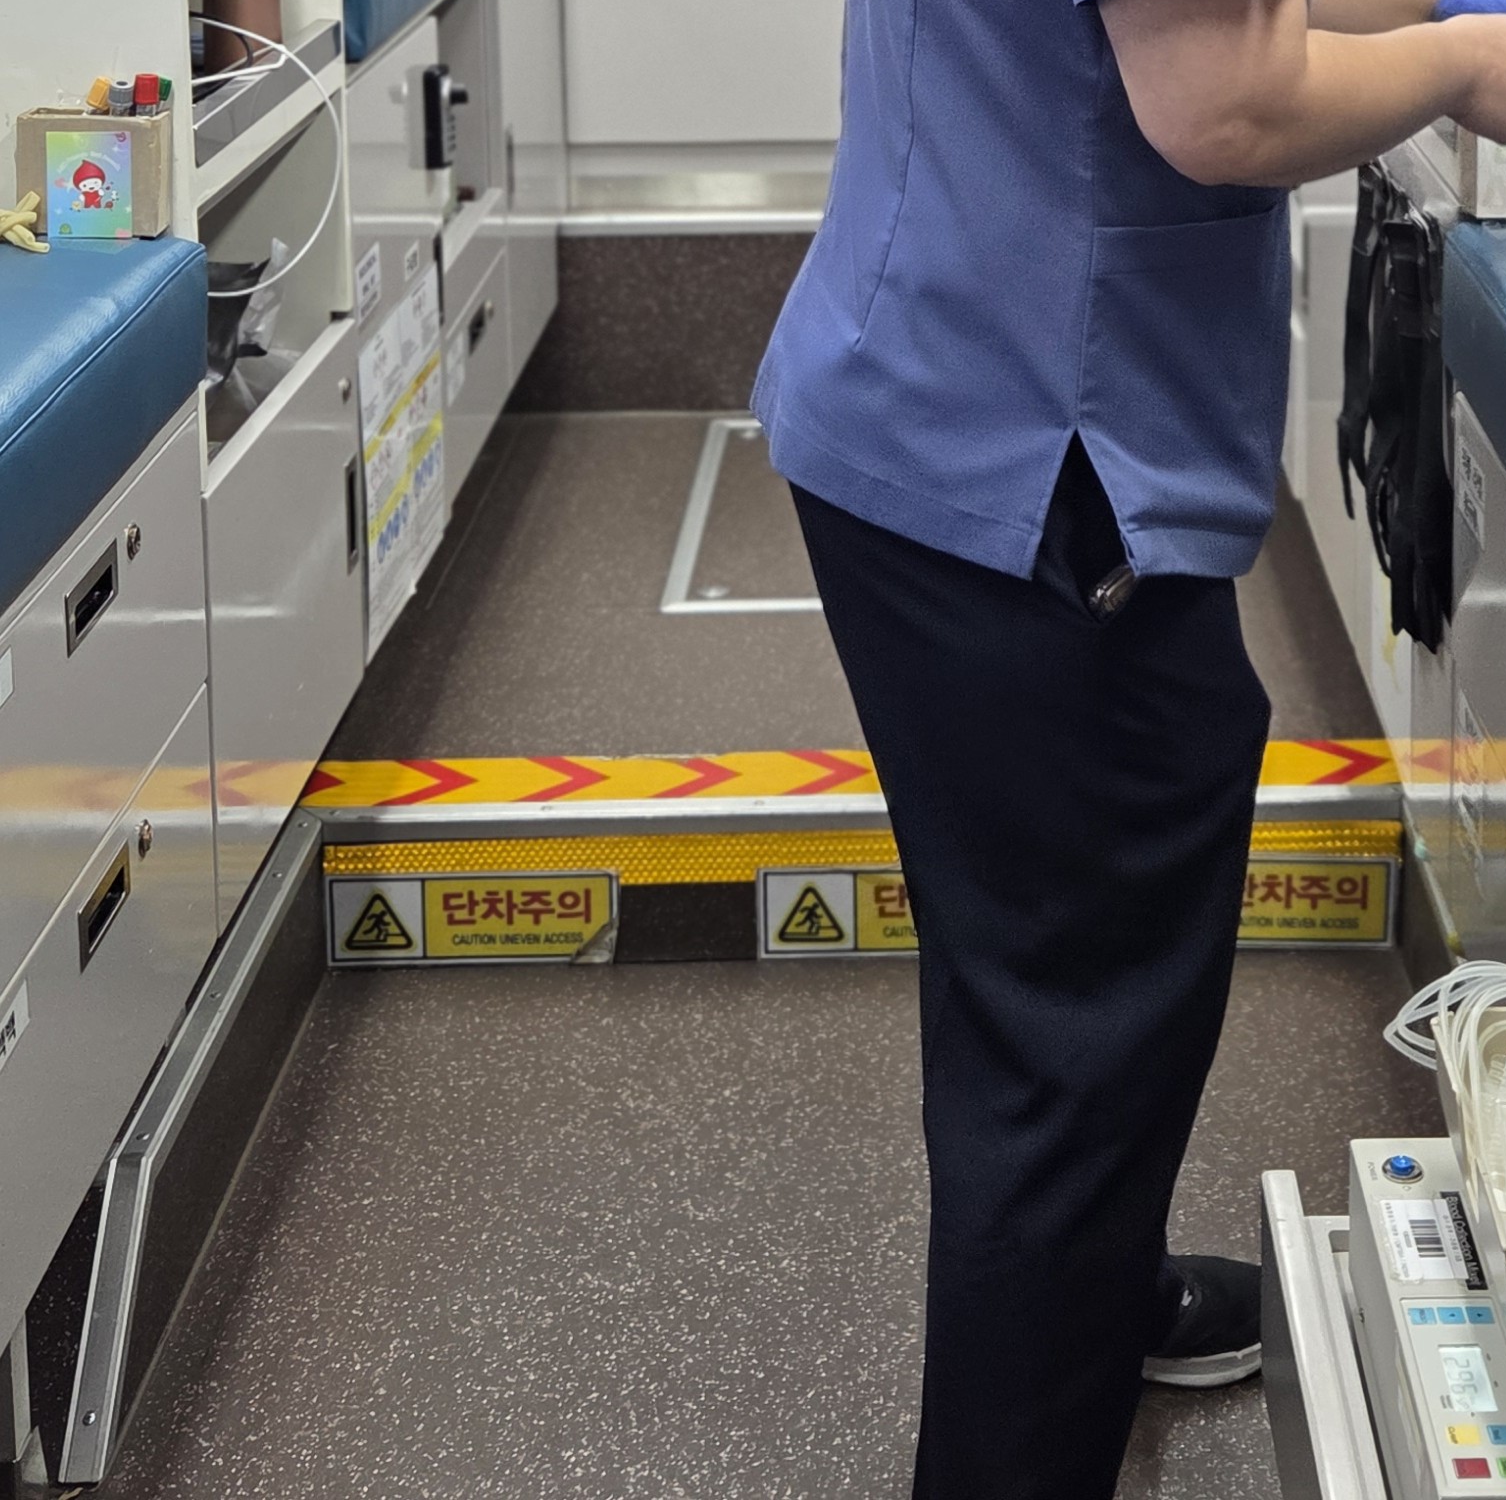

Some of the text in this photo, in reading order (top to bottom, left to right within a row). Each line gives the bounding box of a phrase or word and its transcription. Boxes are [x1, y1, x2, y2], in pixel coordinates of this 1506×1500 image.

[441, 887, 593, 927] 단차주의
[1277, 916, 1316, 929] UNEVEN
[1319, 917, 1360, 930] ACCESS
[452, 931, 584, 946] CAUTION UNEVEN ACCESS
[1445, 1195, 1463, 1220] Blood
